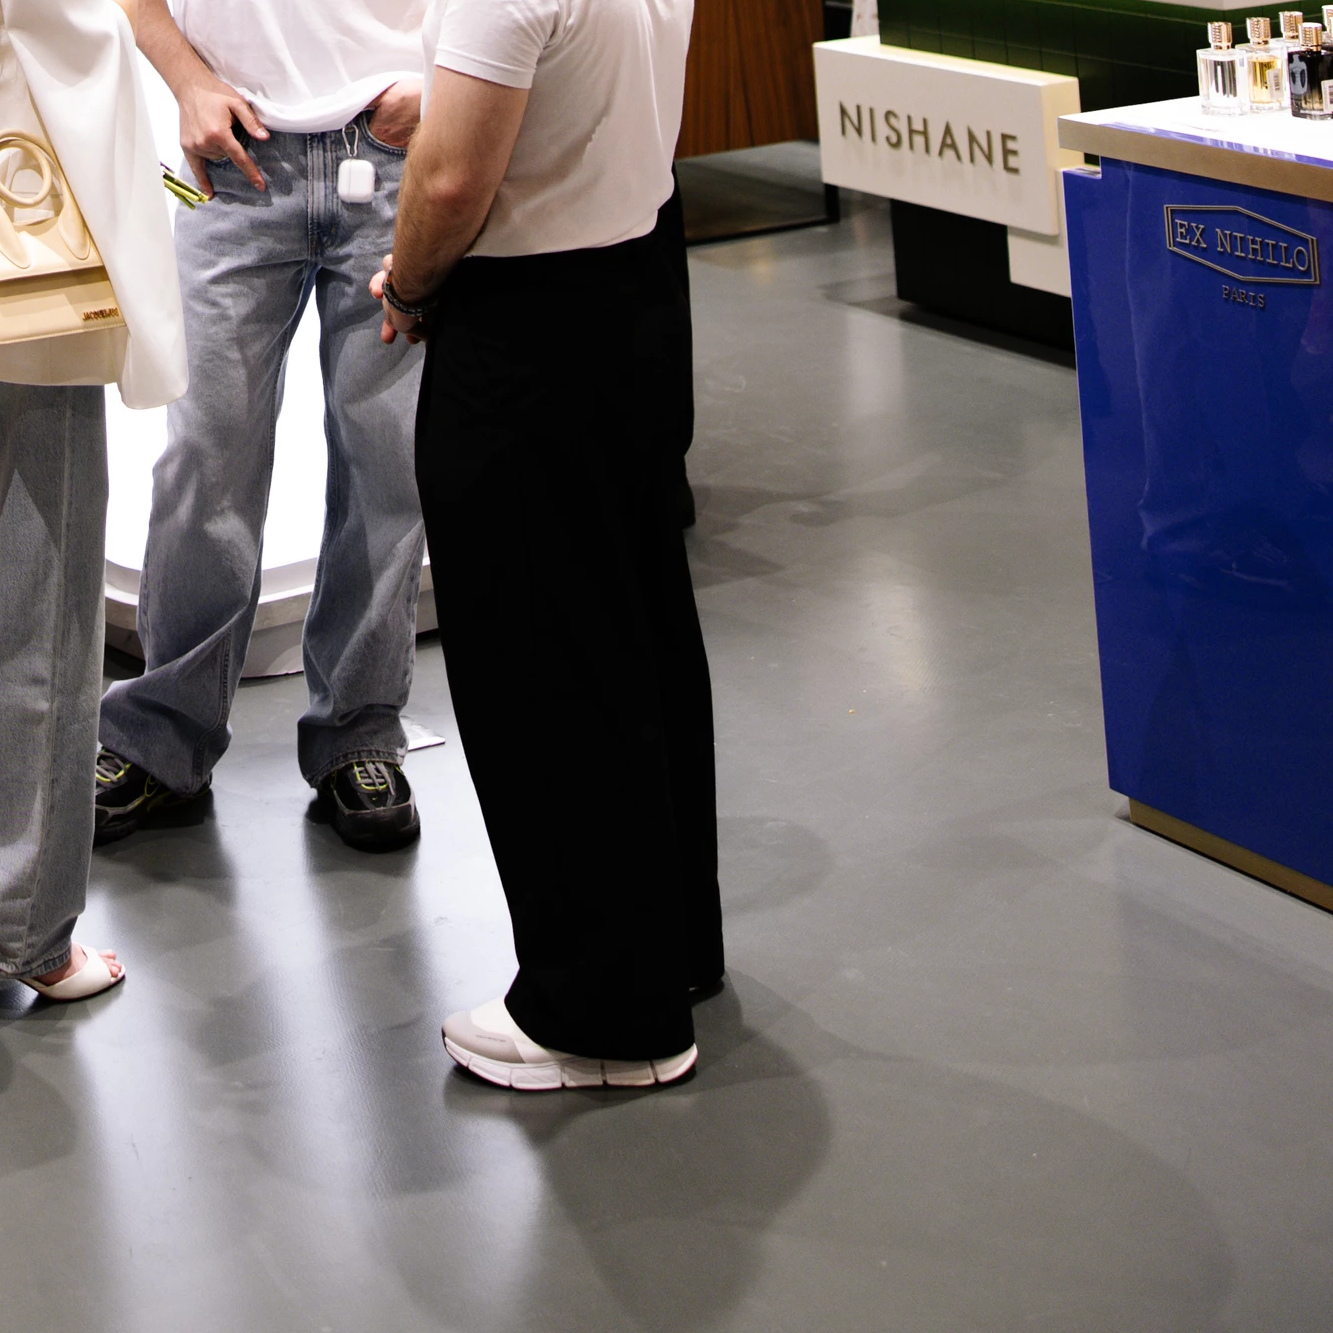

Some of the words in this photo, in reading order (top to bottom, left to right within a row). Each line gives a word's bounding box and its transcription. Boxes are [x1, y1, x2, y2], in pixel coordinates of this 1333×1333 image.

[839, 100, 1020, 176] NISHANE
[1175, 219, 1207, 248] EX
[1215, 228, 1309, 271] NIHILO
[1222, 285, 1266, 308] PARIS
